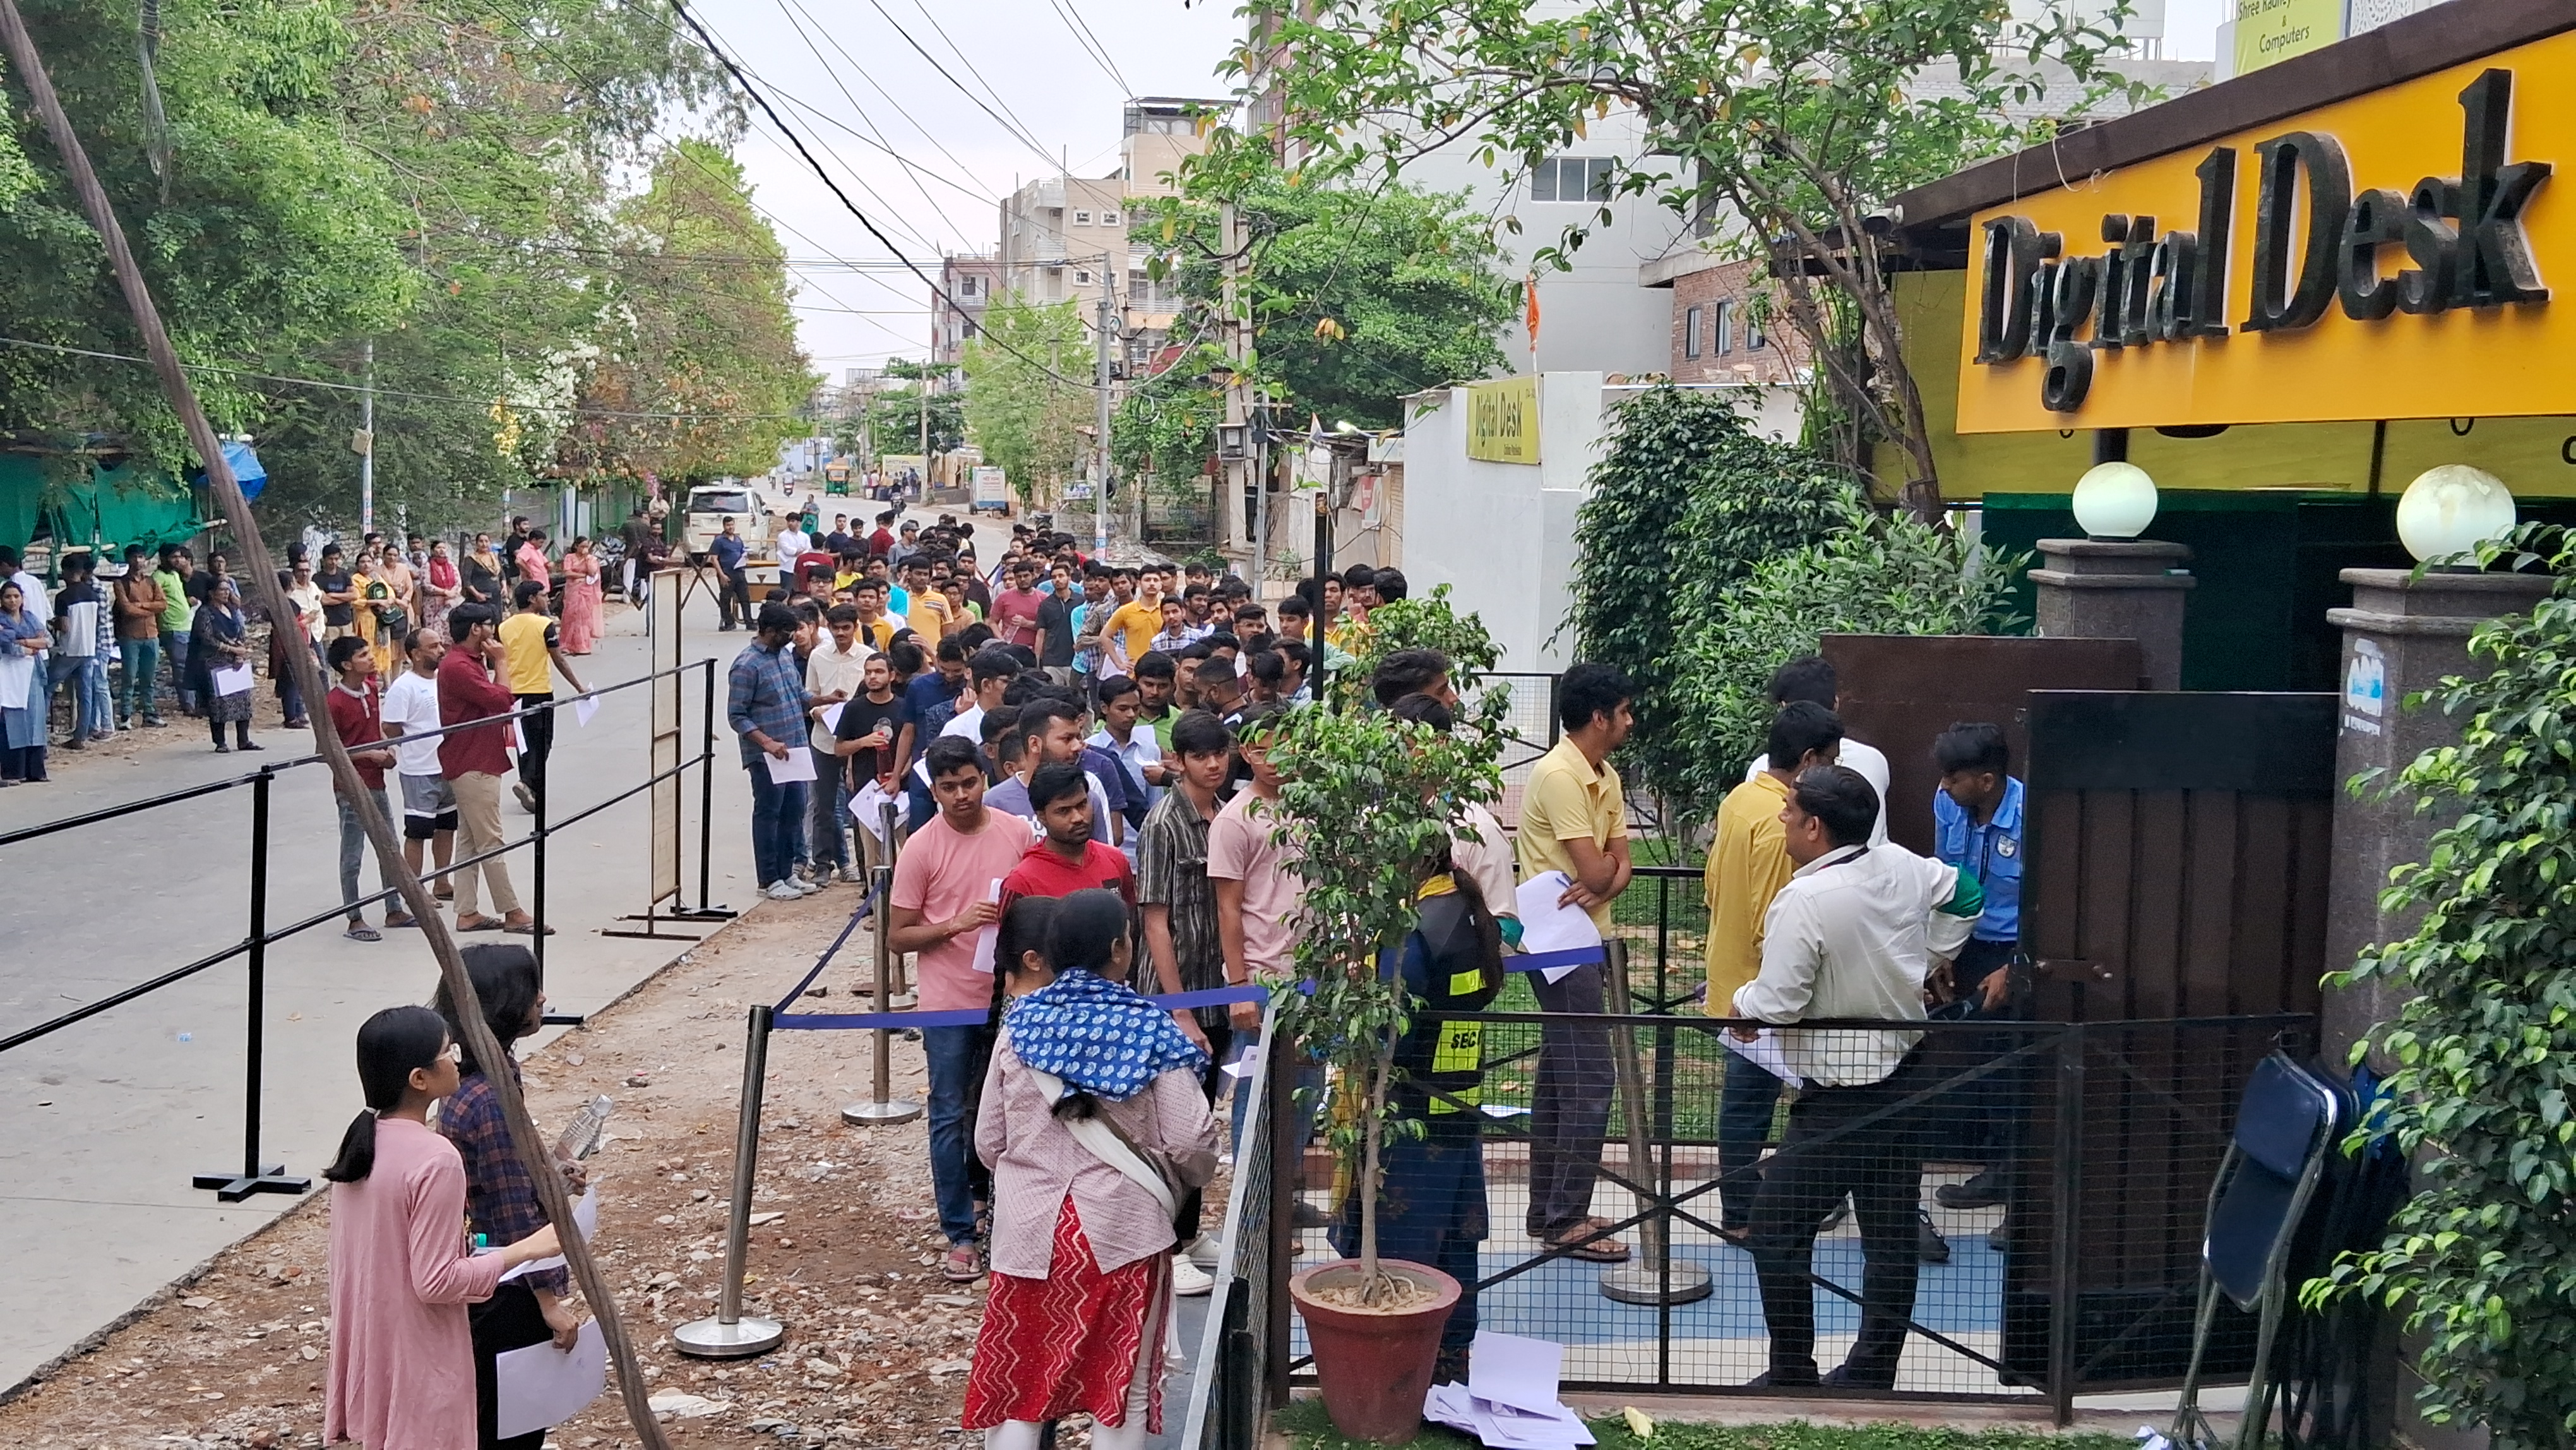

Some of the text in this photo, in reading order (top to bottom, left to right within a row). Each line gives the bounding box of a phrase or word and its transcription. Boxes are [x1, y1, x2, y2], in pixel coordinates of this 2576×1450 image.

[2238, 1, 2260, 21] Shree
[2282, 15, 2287, 27] &
[2259, 25, 2310, 53] Computers
[1973, 68, 2553, 412] Digital Desk
[1476, 390, 1523, 447] Digital Desk
